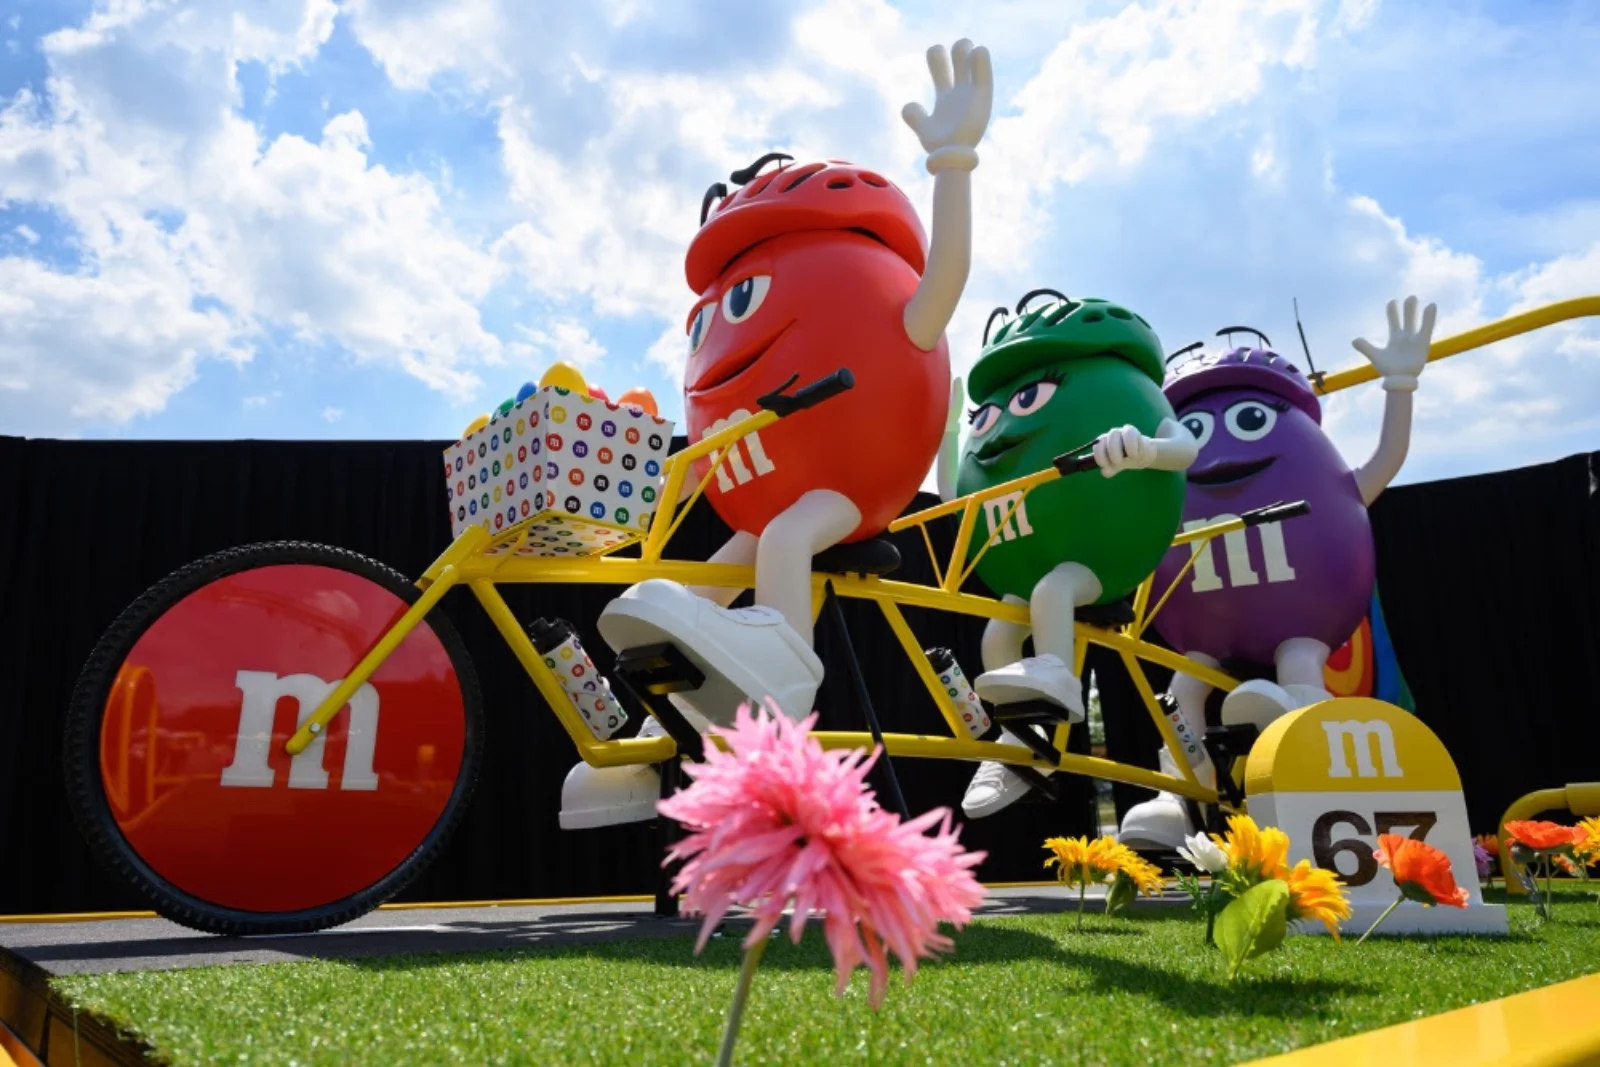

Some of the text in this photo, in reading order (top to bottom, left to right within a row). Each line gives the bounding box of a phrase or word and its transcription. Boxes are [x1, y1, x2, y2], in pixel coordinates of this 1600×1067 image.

[702, 408, 776, 494] m
[982, 490, 1034, 547] m
[1183, 513, 1296, 593] m
[220, 670, 380, 790] m
[1321, 720, 1404, 778] m
